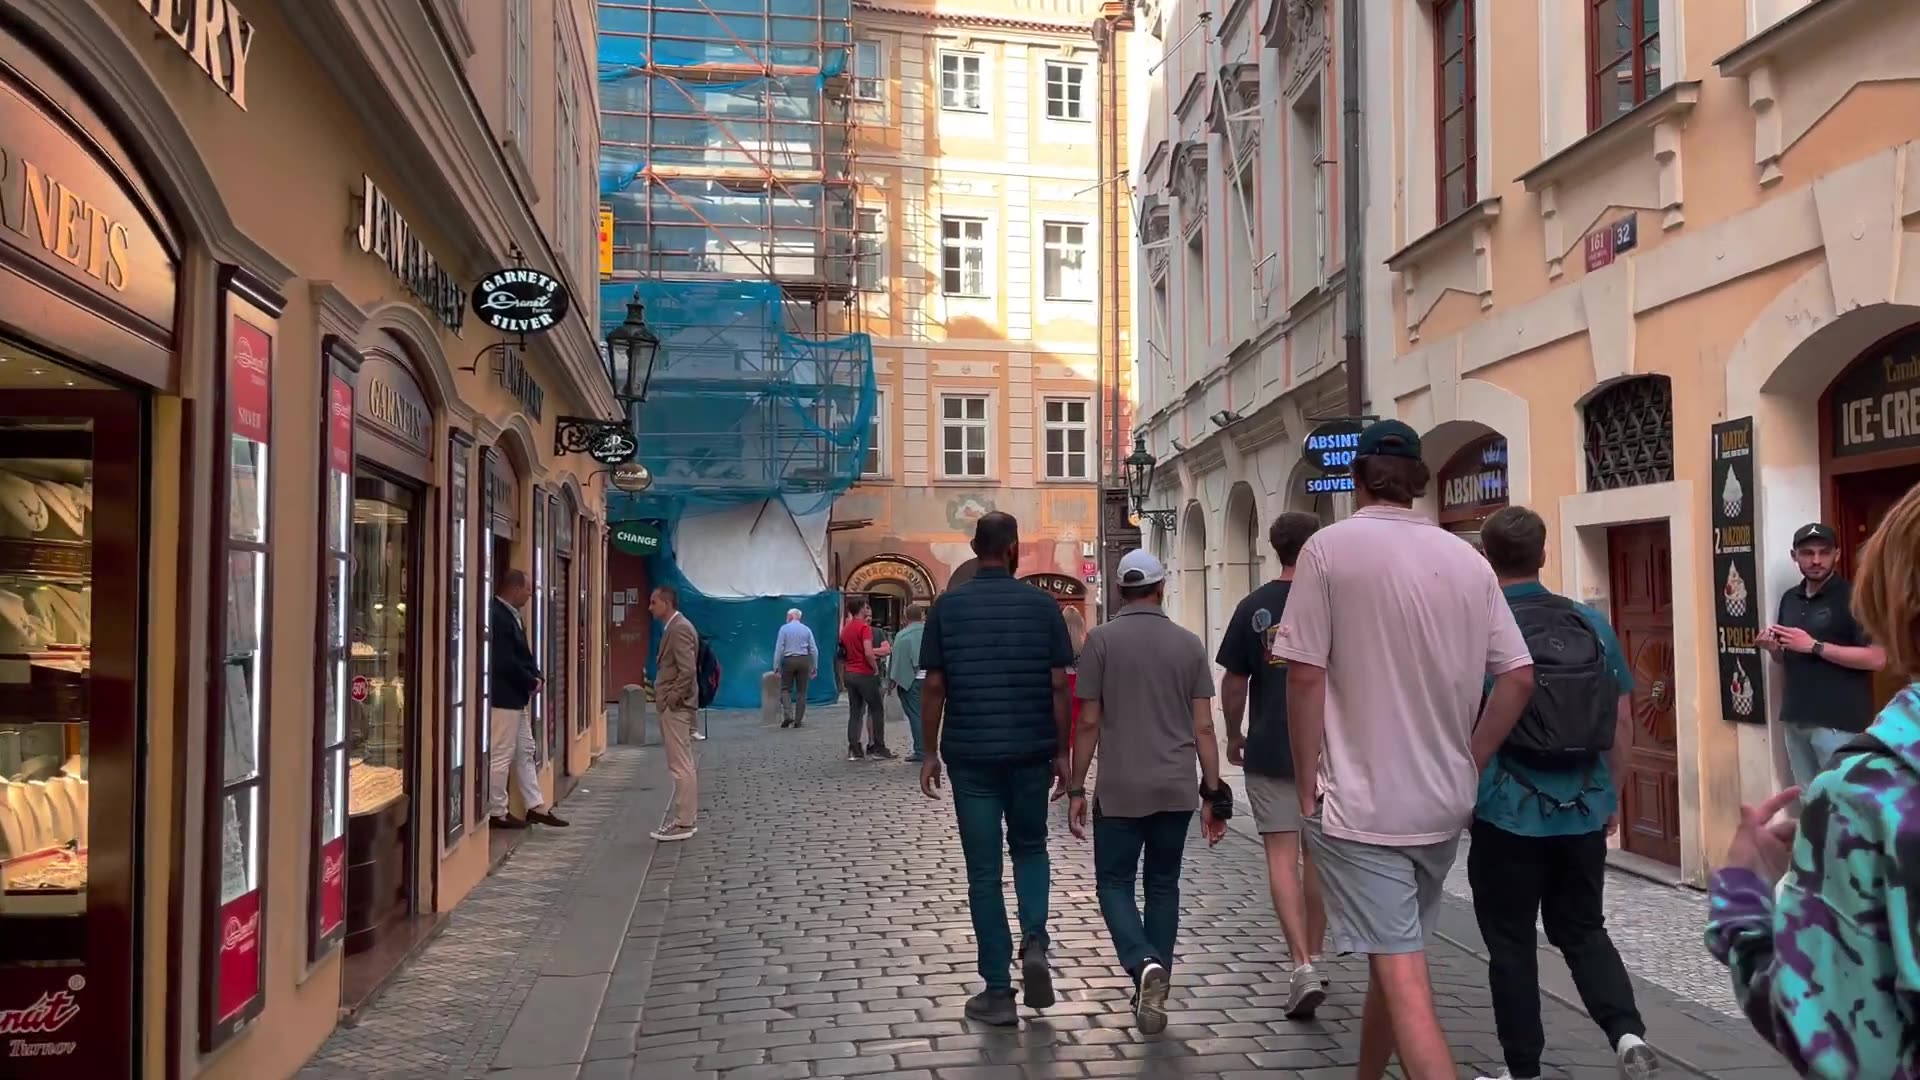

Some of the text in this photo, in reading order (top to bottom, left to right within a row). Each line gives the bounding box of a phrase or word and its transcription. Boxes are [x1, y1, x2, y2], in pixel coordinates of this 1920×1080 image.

[1591, 232, 1604, 252] 161
[1616, 223, 1630, 245] 32
[482, 270, 558, 292] GARNETS
[491, 313, 554, 330] SILVER
[368, 378, 421, 440] GARNETS
[1308, 432, 1362, 450] ABSINT
[1714, 433, 1719, 461] 1
[1444, 469, 1502, 506] ABSINTH
[617, 531, 658, 547] CHANGE
[1714, 527, 1721, 554] 2
[1719, 626, 1727, 653] 3
[9, 1039, 77, 1057] Turnov
